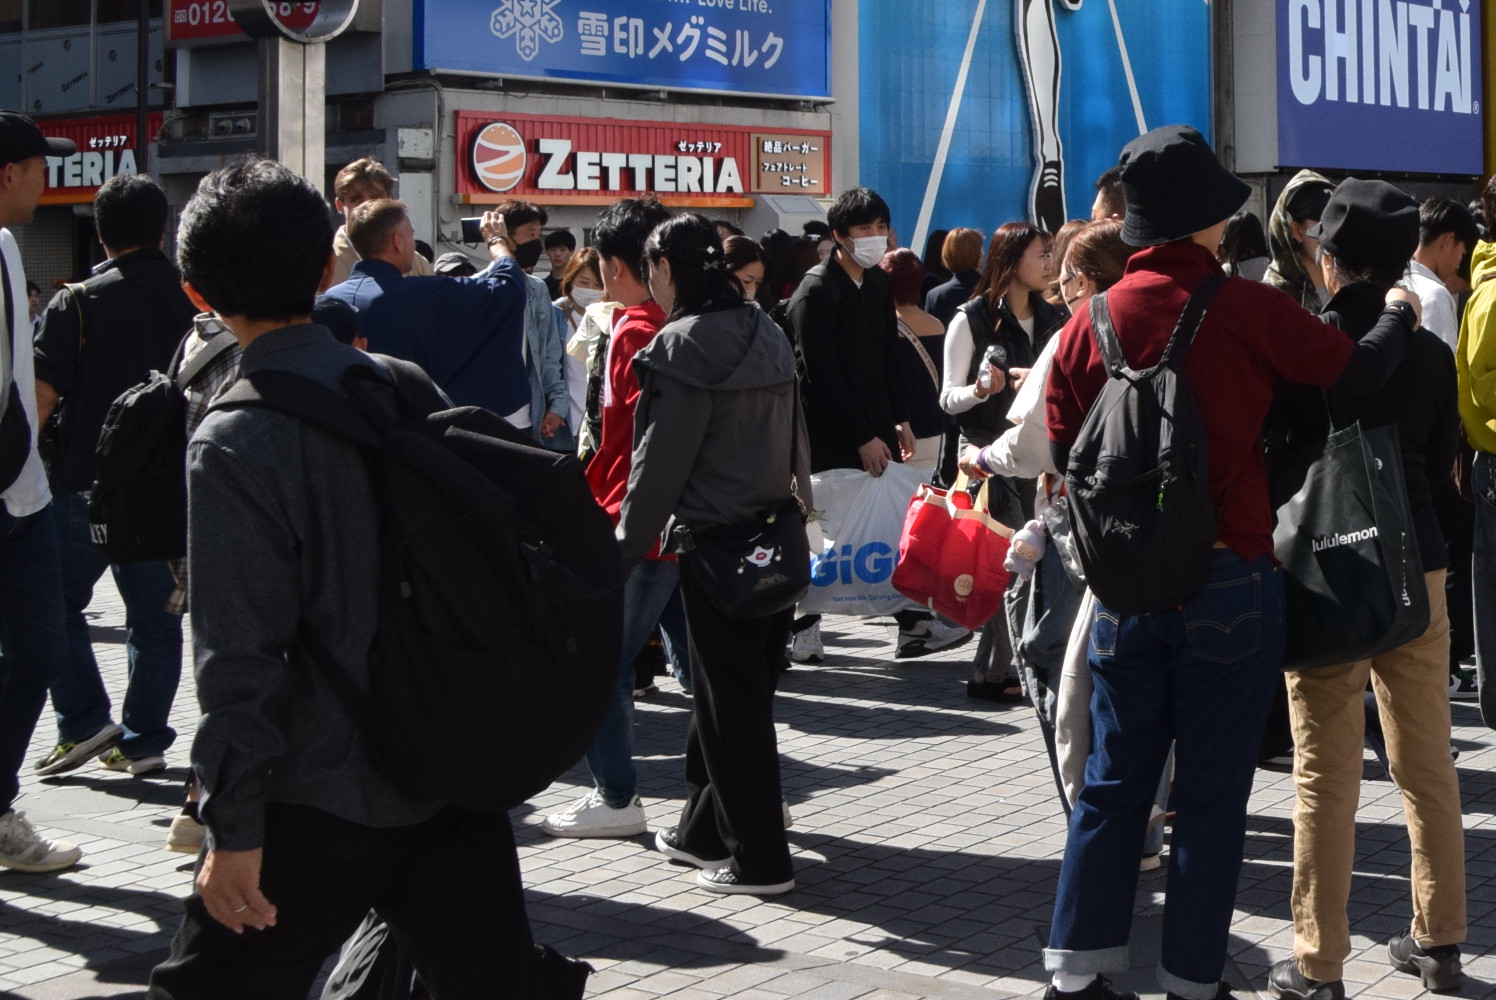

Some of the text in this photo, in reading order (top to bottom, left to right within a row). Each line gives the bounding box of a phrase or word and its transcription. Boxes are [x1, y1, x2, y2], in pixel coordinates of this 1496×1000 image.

[577, 11, 784, 71] 雪印メグミルク
[90, 135, 127, 148] ゼッテリア
[678, 140, 722, 155] ゼッテリア
[763, 140, 818, 154] 絶品バーガー
[46, 148, 137, 188] TERIA
[537, 138, 744, 194] ZETTERIA
[763, 162, 807, 173] フェアトレード
[782, 176, 818, 187] コーヒー
[1312, 526, 1378, 553] lululemon
[811, 541, 900, 587] GiG
